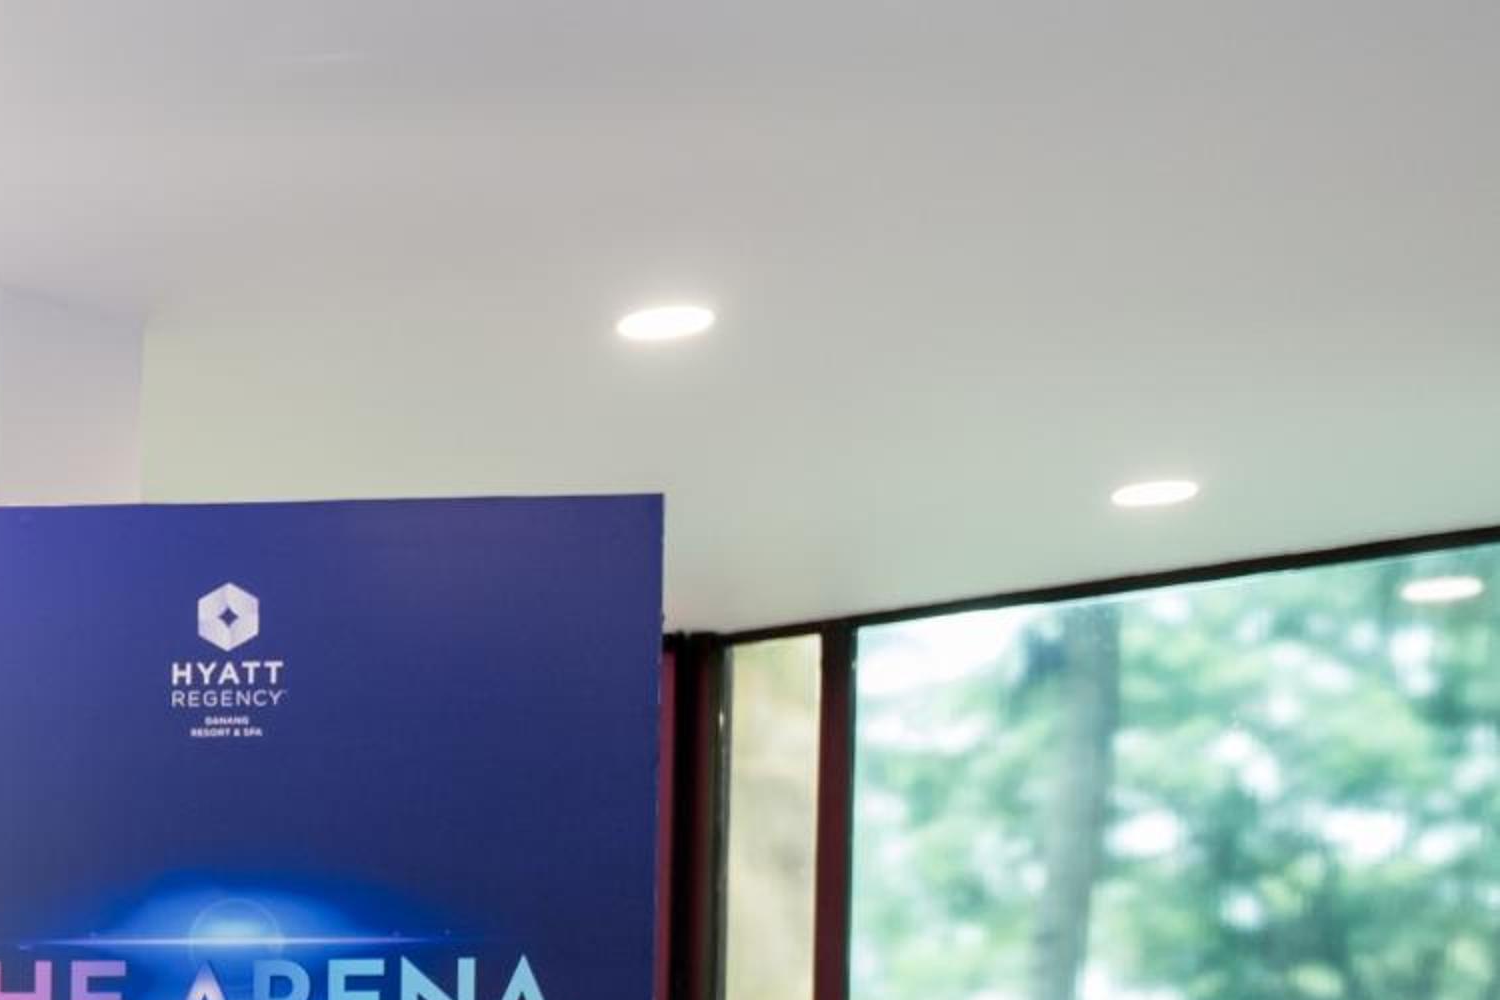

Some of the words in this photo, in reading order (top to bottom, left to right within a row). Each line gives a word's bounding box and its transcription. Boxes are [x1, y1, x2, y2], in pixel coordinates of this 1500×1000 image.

[171, 661, 284, 685] HYATT
[171, 689, 283, 707] REGENCY
[190, 728, 230, 738] RESORT
[233, 728, 241, 737] &
[243, 727, 263, 737] SPA
